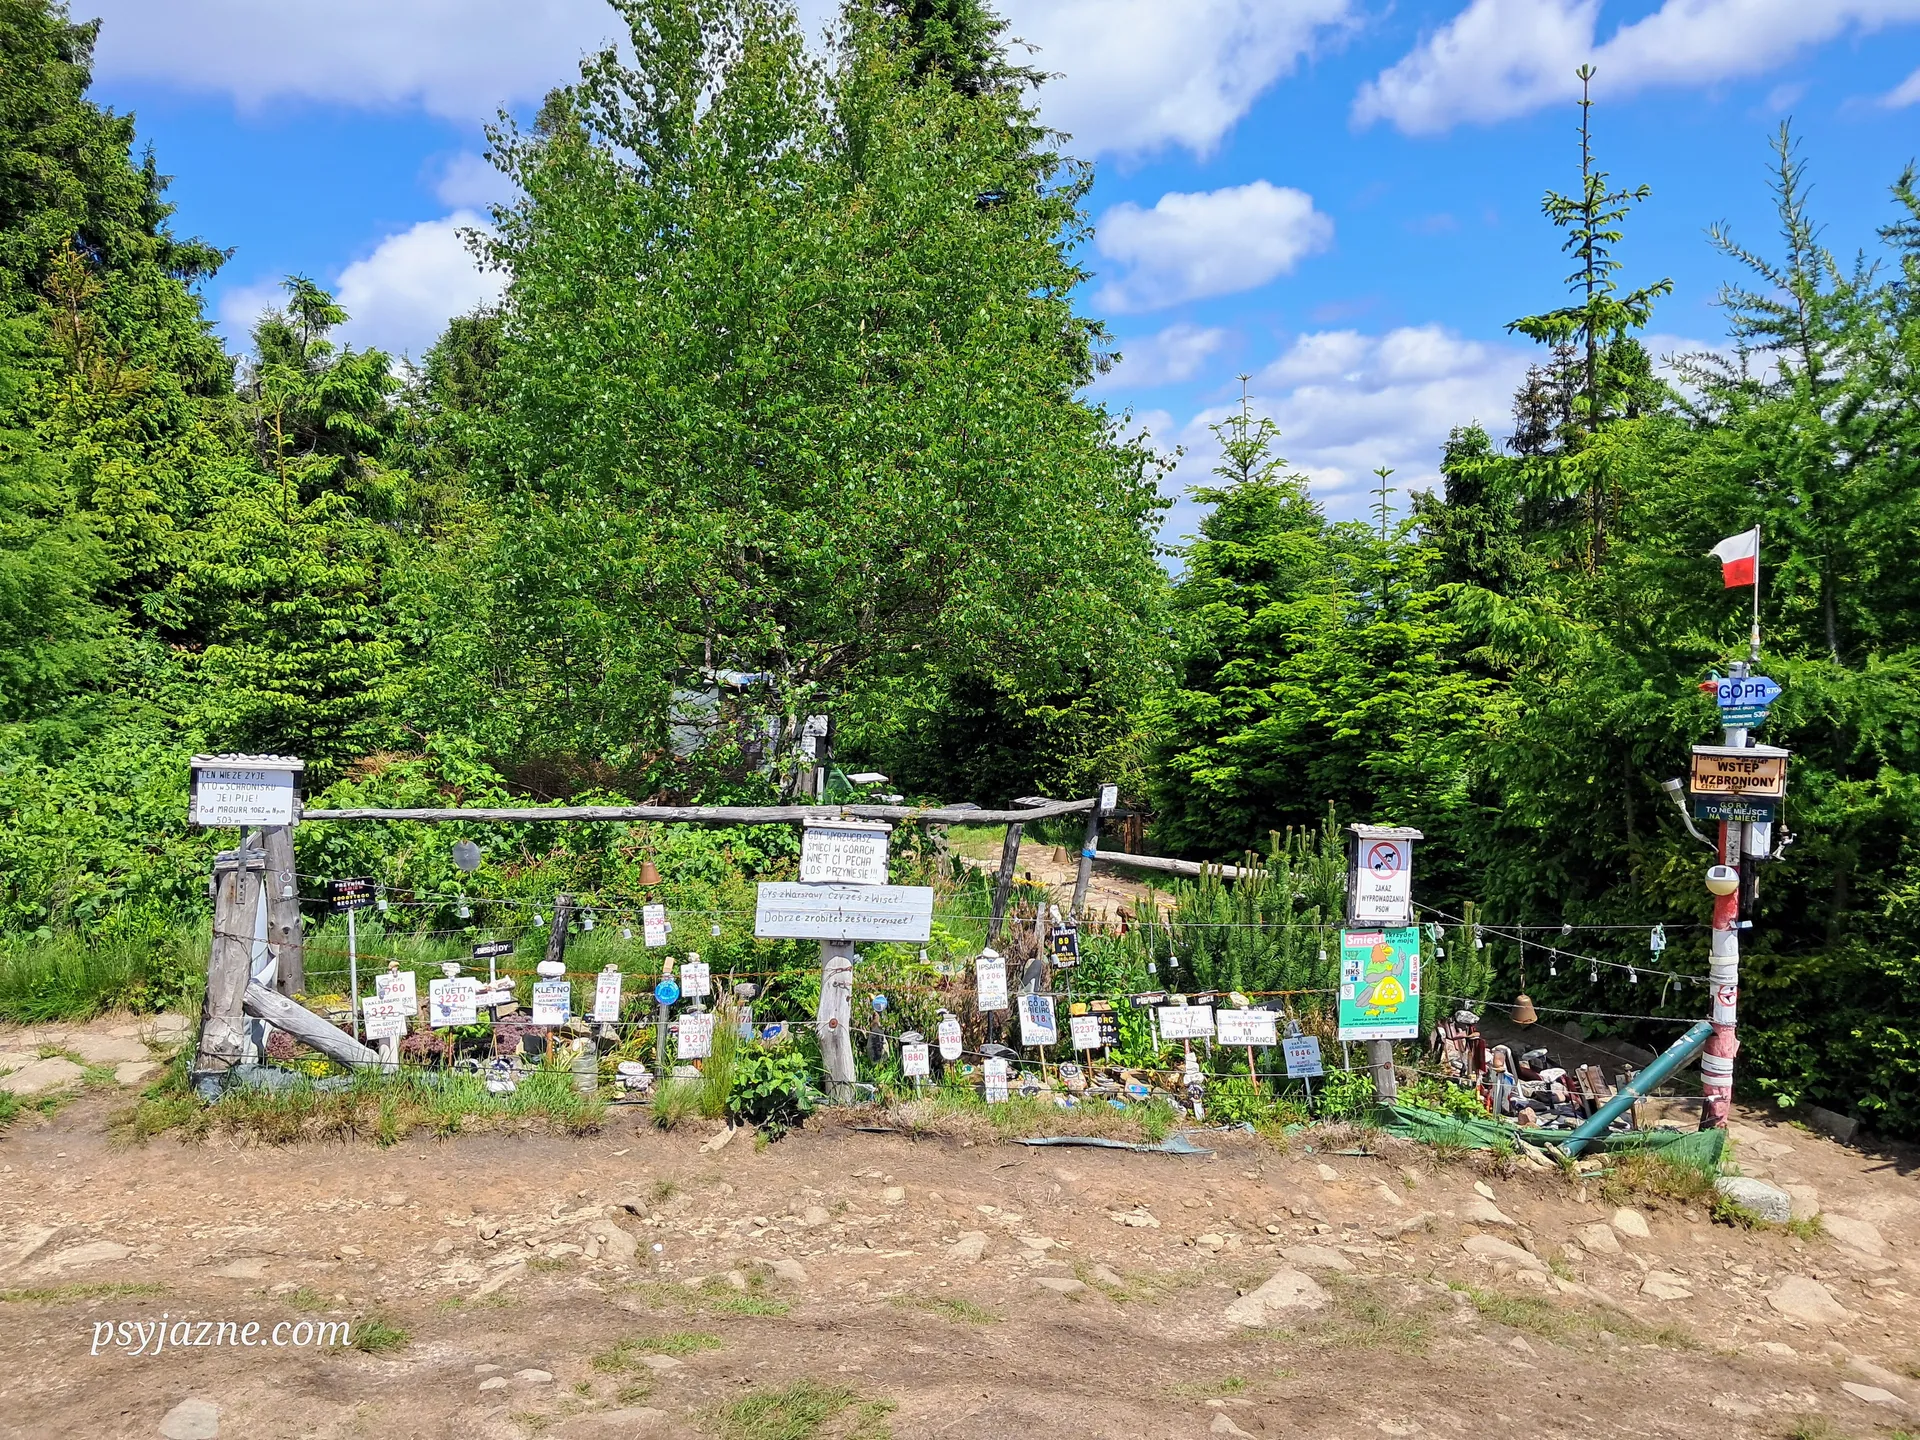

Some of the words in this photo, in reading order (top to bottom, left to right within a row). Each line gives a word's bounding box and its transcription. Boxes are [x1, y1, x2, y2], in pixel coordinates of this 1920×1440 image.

[1718, 684, 1766, 699] GOPR
[1718, 762, 1760, 775] WSTĘP
[201, 770, 216, 779] TEN
[1699, 775, 1776, 787] WZBRONIONY
[201, 782, 217, 790] KTO
[226, 783, 276, 791] SCHRONISKU
[1733, 808, 1768, 816] MIEJSCE
[808, 830, 824, 840] GDY
[843, 843, 875, 855] GÓRACH
[832, 854, 840, 865] CI
[846, 856, 872, 866] PECHA
[805, 865, 822, 874] LOS
[1375, 904, 1389, 912] PSÓW
[764, 911, 800, 923] Dobrze
[645, 918, 664, 926] 5636
[434, 986, 474, 995] CIVETTA
[980, 1000, 1007, 1008] GRECJA
[372, 1005, 394, 1016] 322
[1165, 1026, 1183, 1036] ALPY
[940, 1036, 960, 1044] 6180
